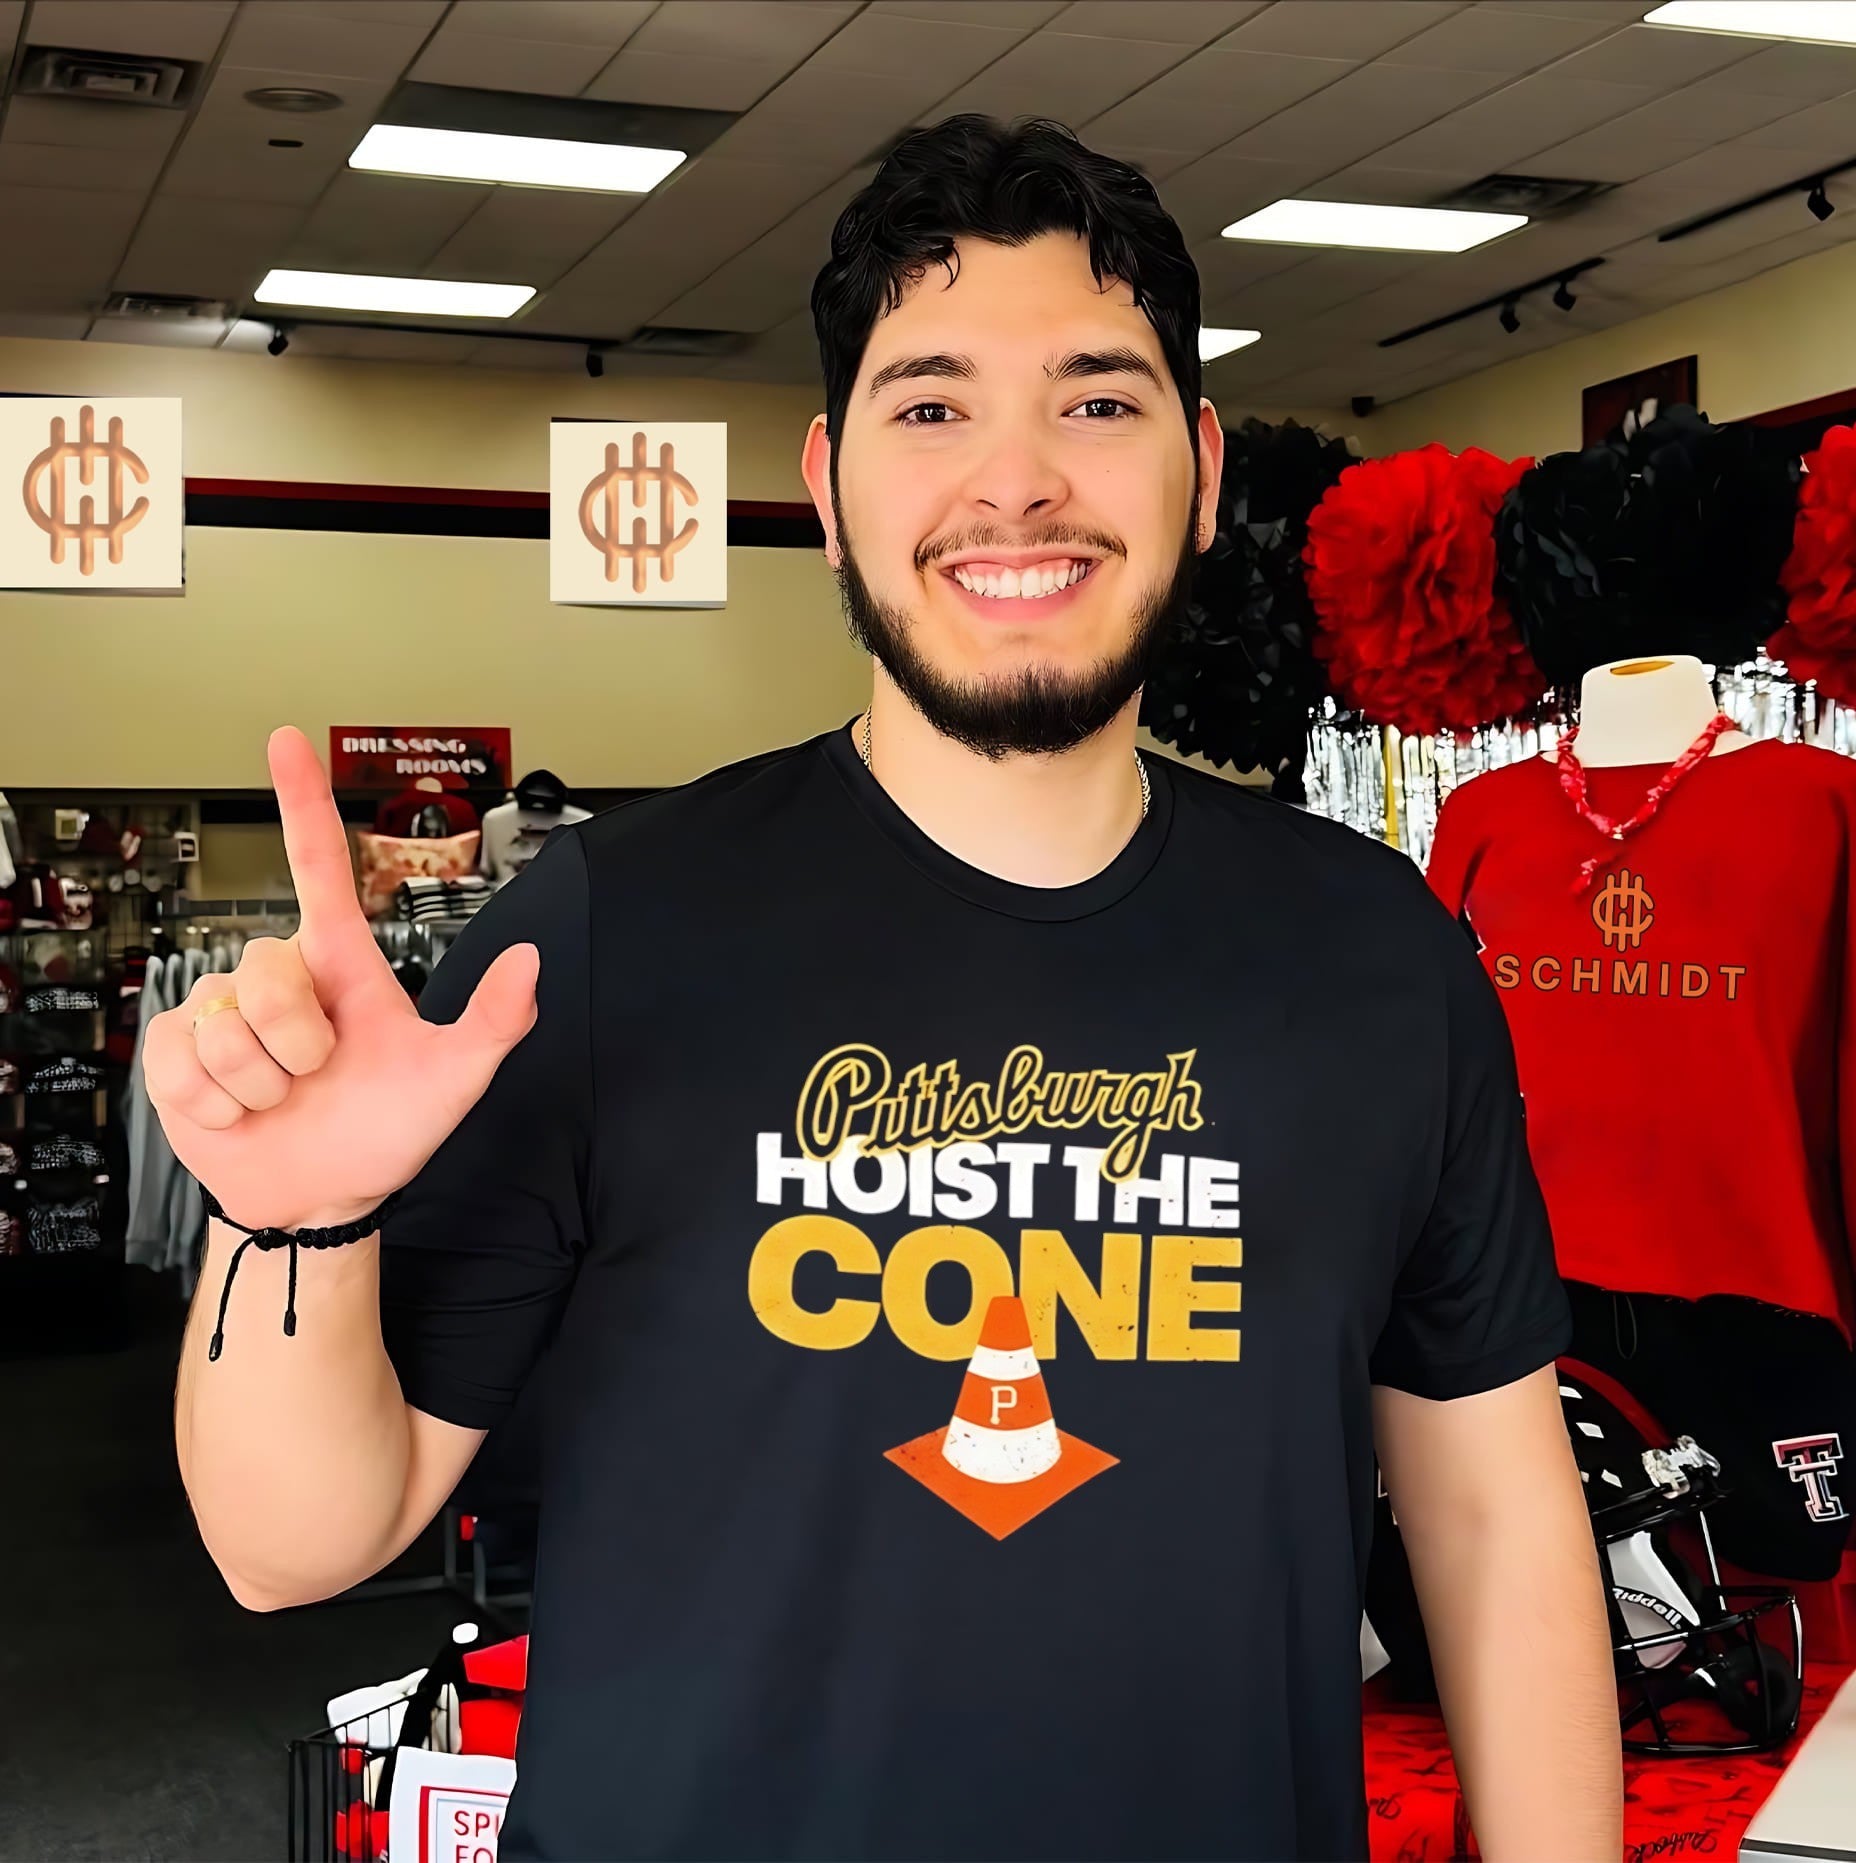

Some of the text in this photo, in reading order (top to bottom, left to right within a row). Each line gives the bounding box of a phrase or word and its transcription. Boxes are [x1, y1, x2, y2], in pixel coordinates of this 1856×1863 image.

[342, 737, 467, 753] DRESSING
[396, 759, 487, 775] ROOMS
[1494, 954, 1747, 1000] SCHMIDT
[796, 1043, 1204, 1183] Pittsburgh
[756, 1132, 1241, 1228] HOIST THE
[747, 1215, 1243, 1362] CONE
[989, 1385, 1018, 1425] P
